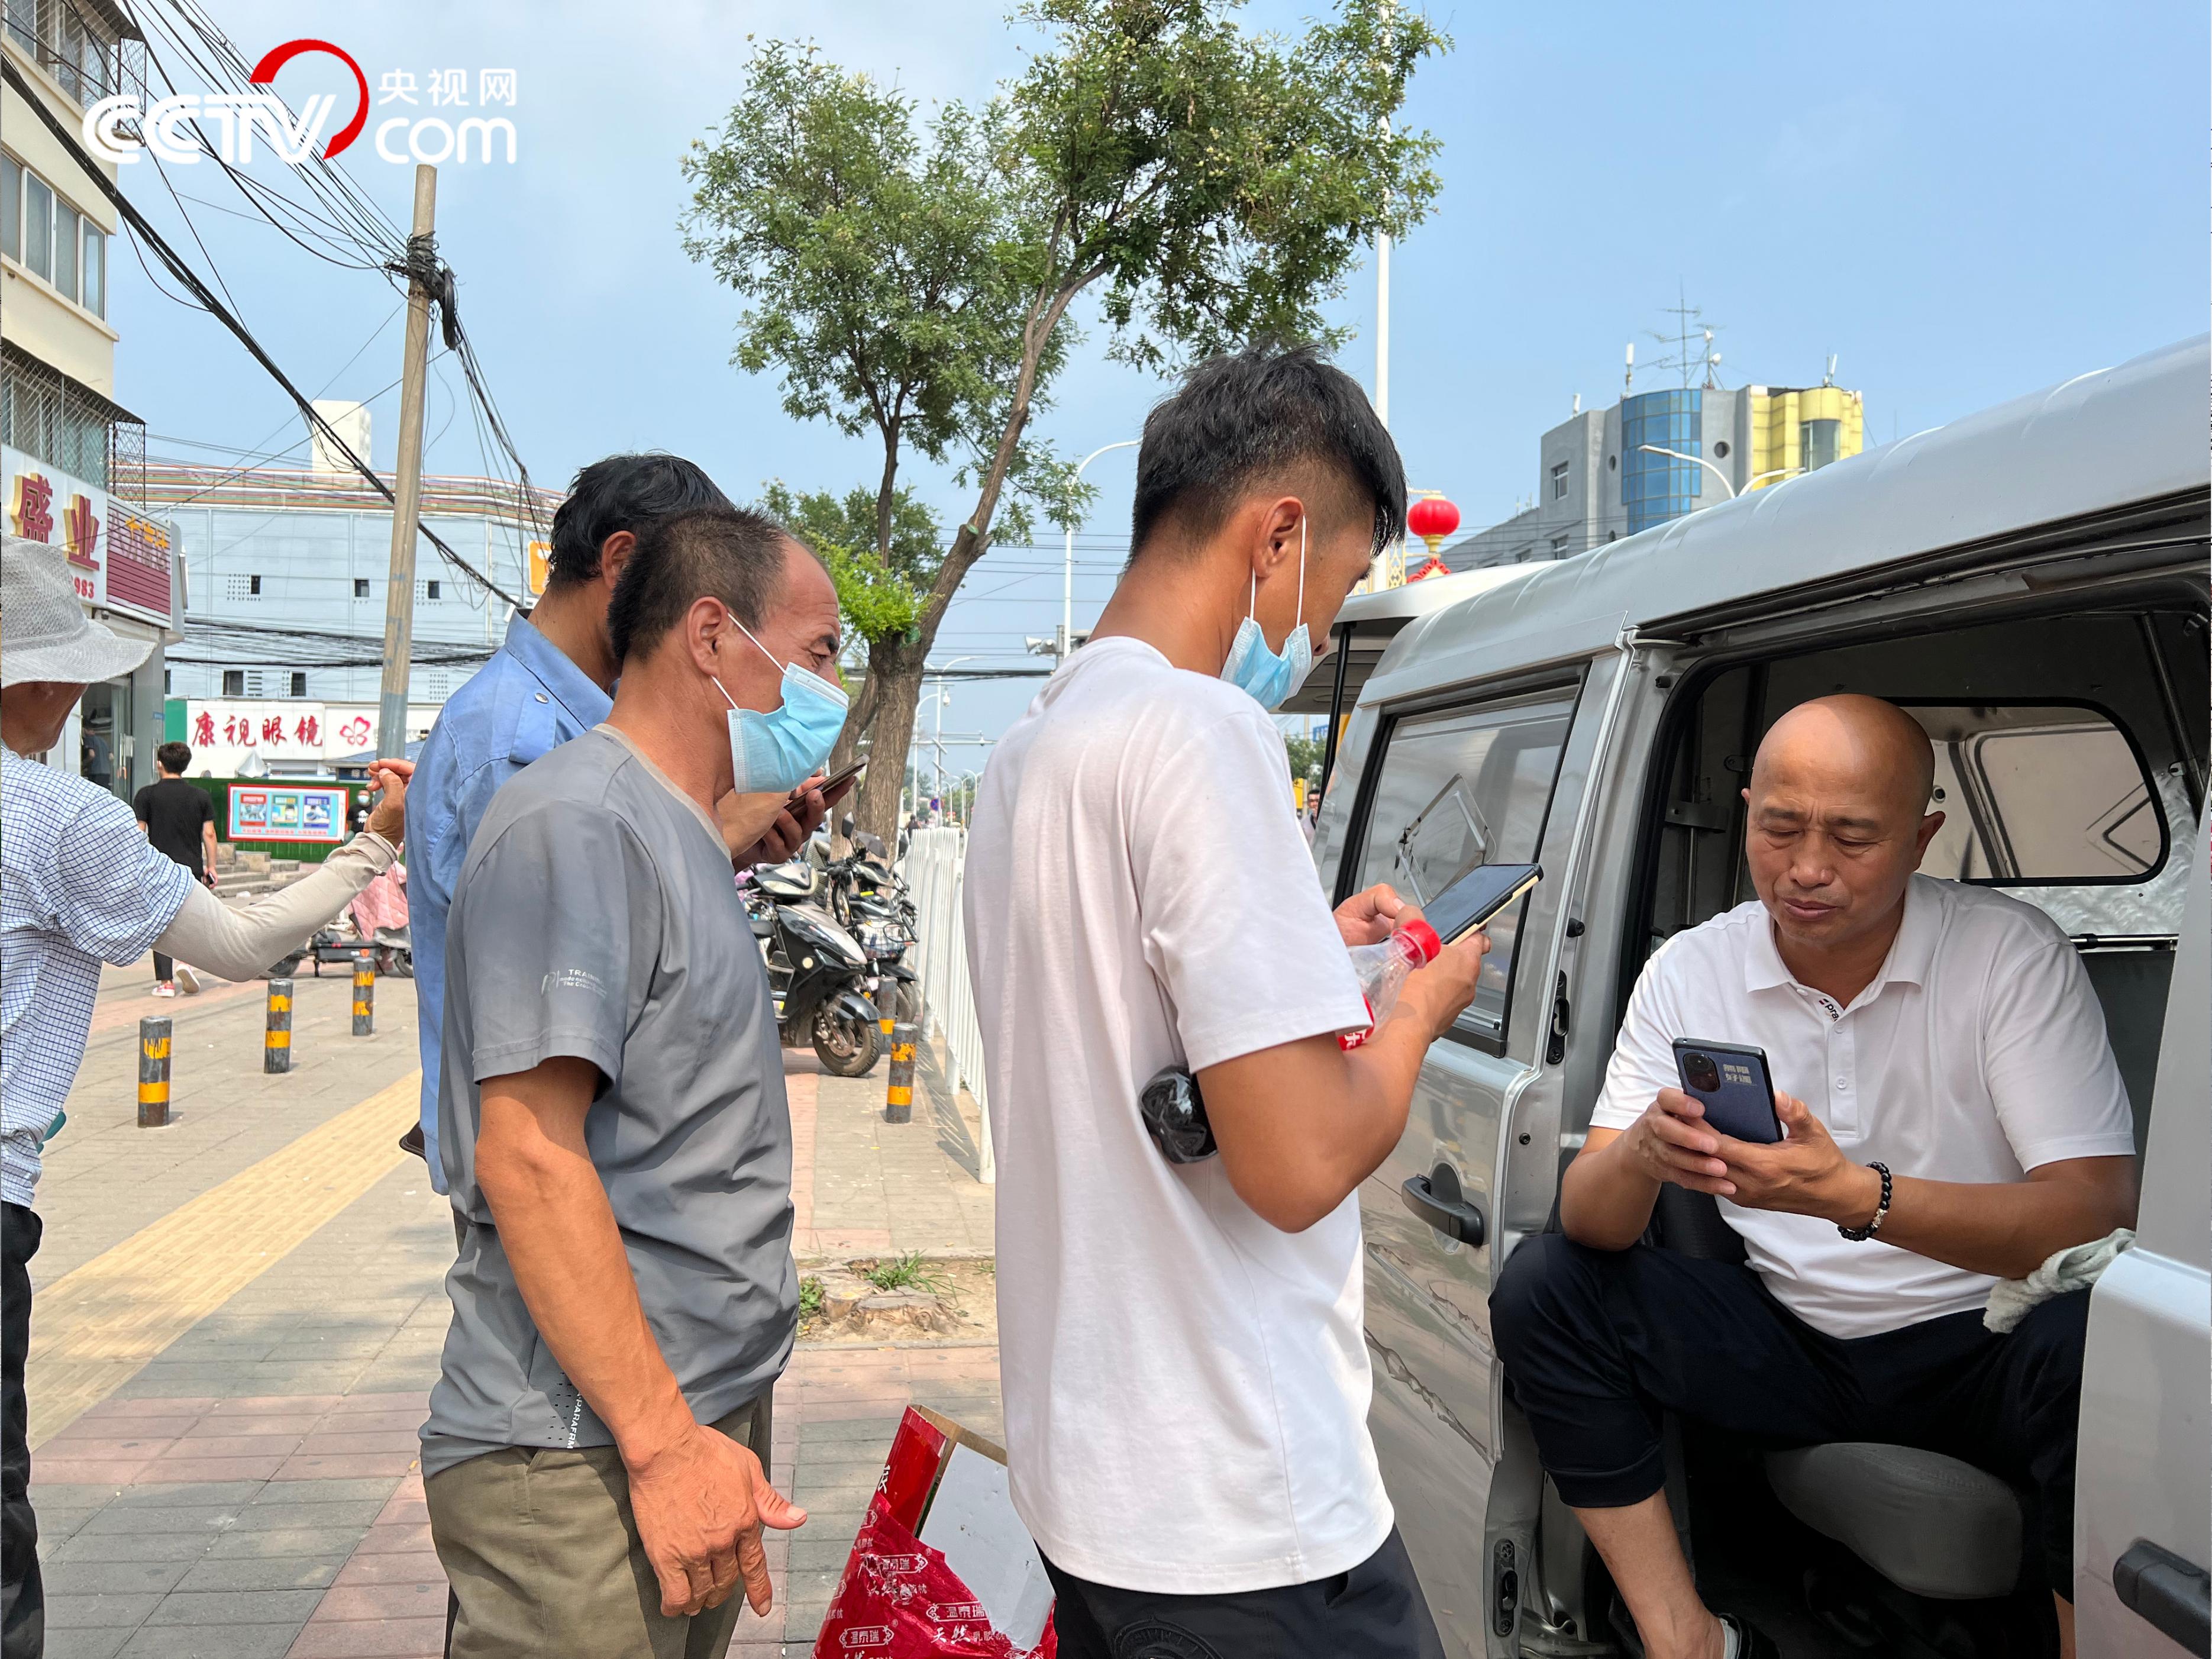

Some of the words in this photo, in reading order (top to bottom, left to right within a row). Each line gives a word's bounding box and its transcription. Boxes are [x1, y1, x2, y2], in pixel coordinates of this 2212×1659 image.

[11, 472, 100, 572] 盛业
[69, 574, 95, 600] 983
[192, 710, 323, 748] 康视眼镜
